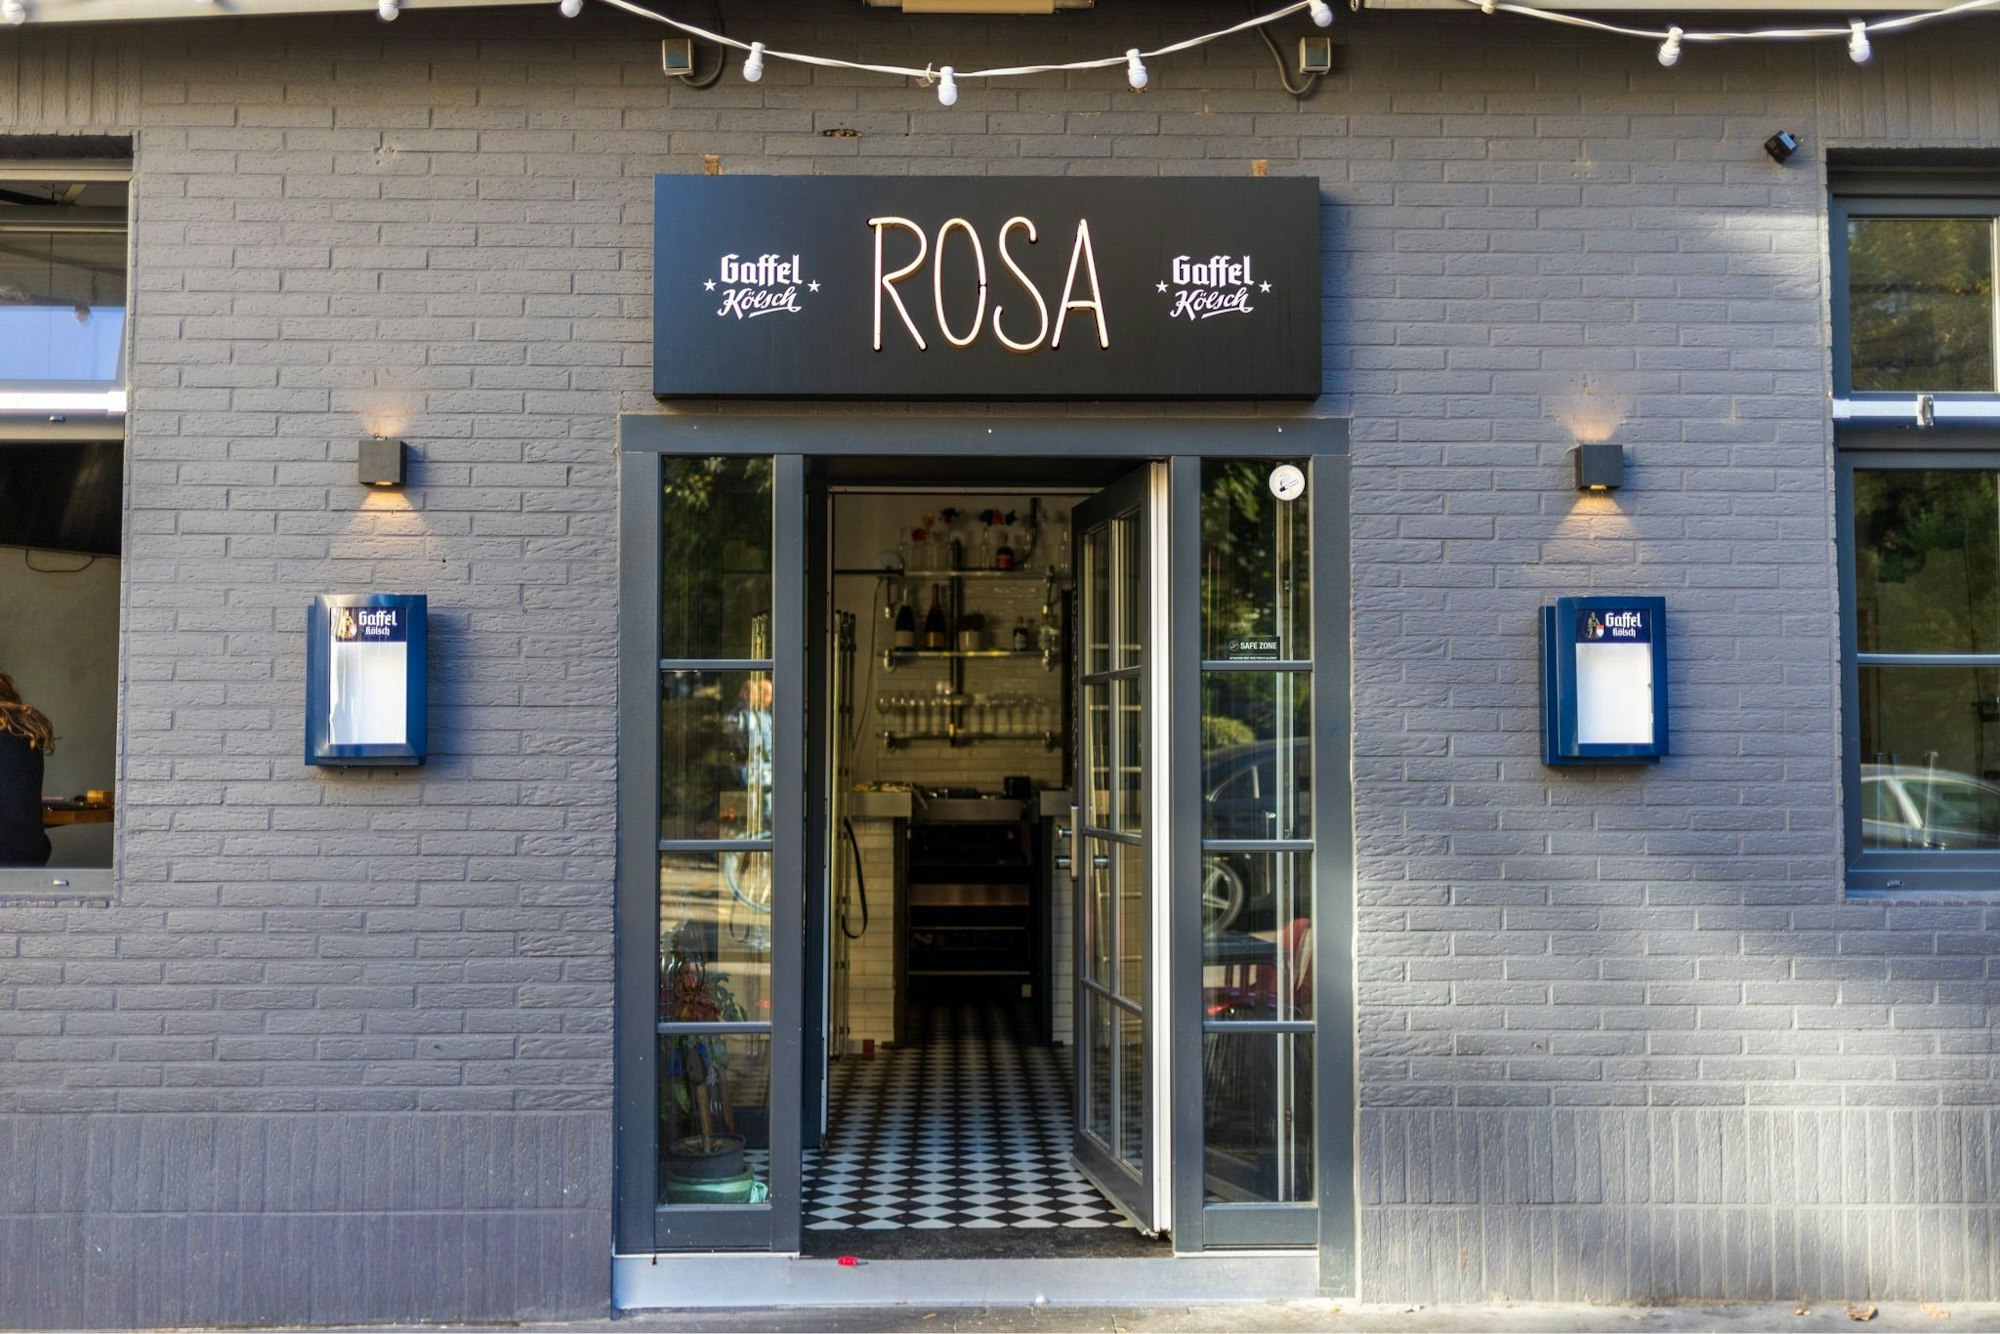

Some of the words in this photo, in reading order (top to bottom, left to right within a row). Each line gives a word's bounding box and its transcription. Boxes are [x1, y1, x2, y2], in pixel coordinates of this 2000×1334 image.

[721, 253, 803, 287] Gaffel
[1172, 255, 1255, 288] Gaffel
[867, 216, 1110, 351] ROSA
[717, 286, 802, 320] Kölsch
[1169, 287, 1254, 321] Kölsch
[358, 610, 398, 626] Gaffel
[1605, 611, 1642, 627] Gaffel
[366, 626, 390, 636] Kölsch
[1613, 627, 1636, 637] Kölsch
[1240, 641, 1258, 650] SAFE
[1259, 641, 1277, 650] ZONE
